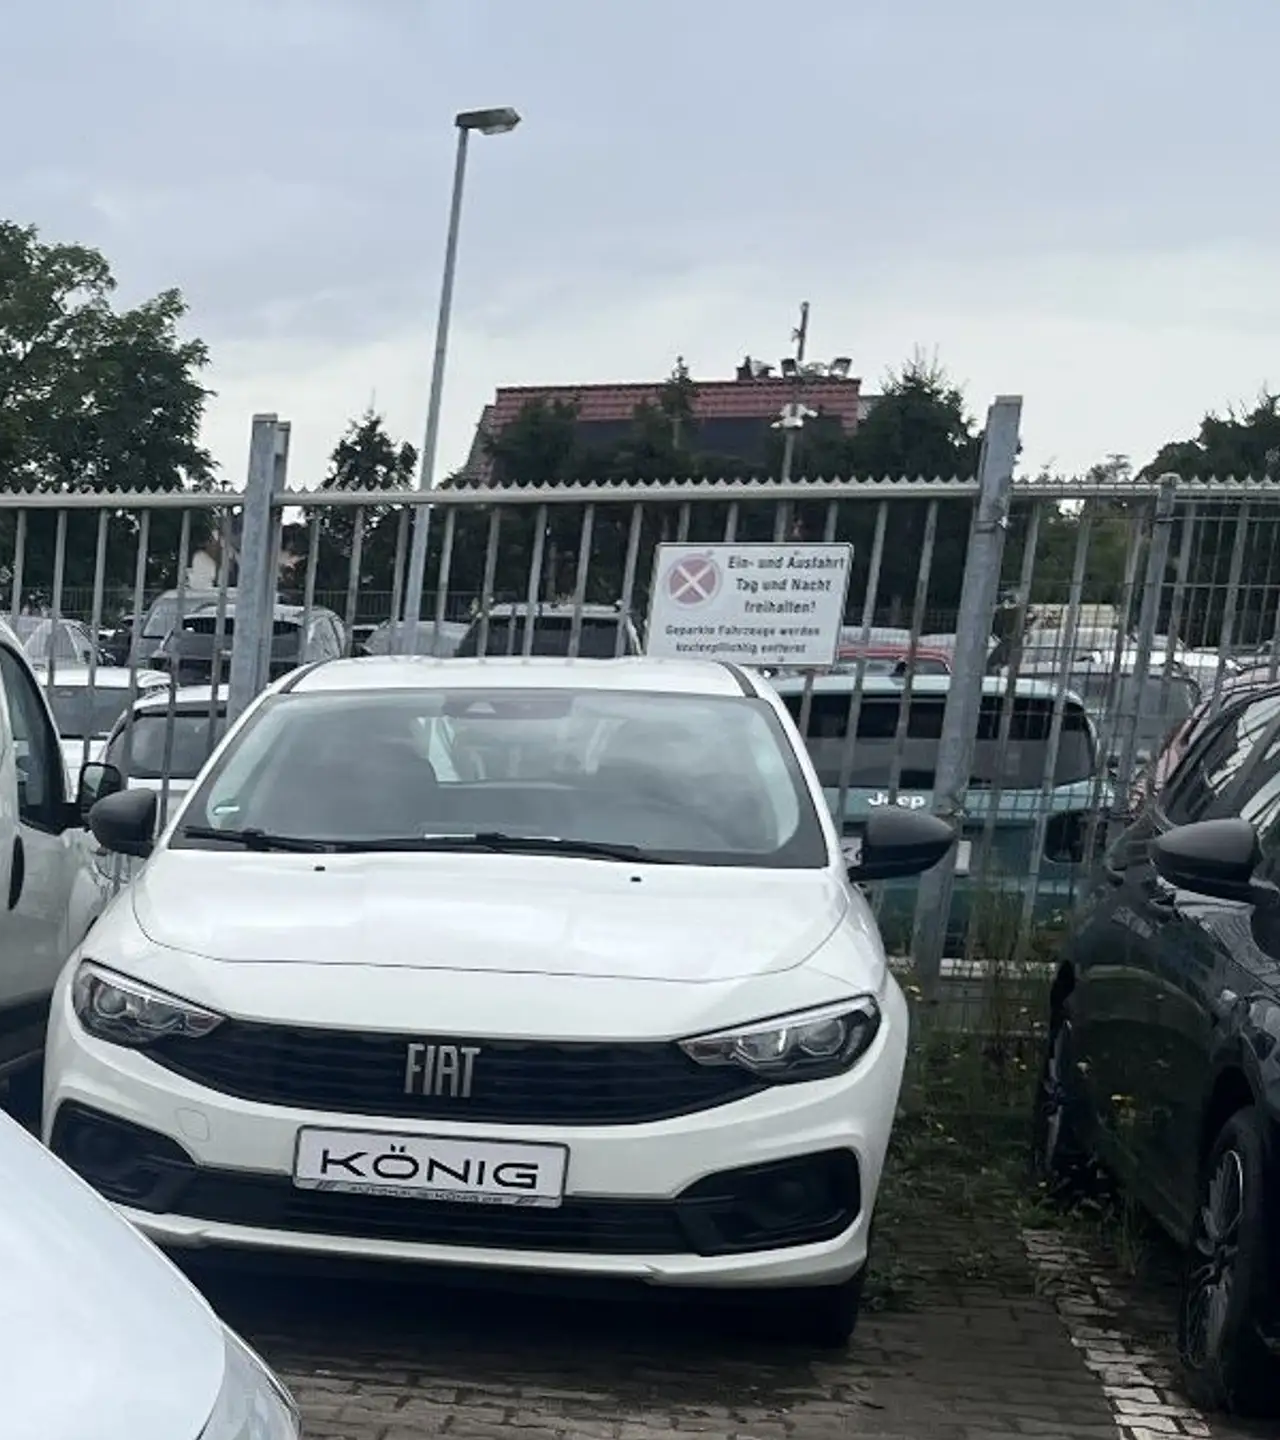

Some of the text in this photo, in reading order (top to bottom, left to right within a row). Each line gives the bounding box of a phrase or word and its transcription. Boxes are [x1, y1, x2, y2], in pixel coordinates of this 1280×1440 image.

[727, 555, 845, 570] Ein- und Ausfahrt
[736, 578, 832, 594] Tag und Nacht
[866, 791, 926, 811] Jep
[403, 1042, 481, 1098] FIAT
[319, 1143, 539, 1190] KÖNIG
